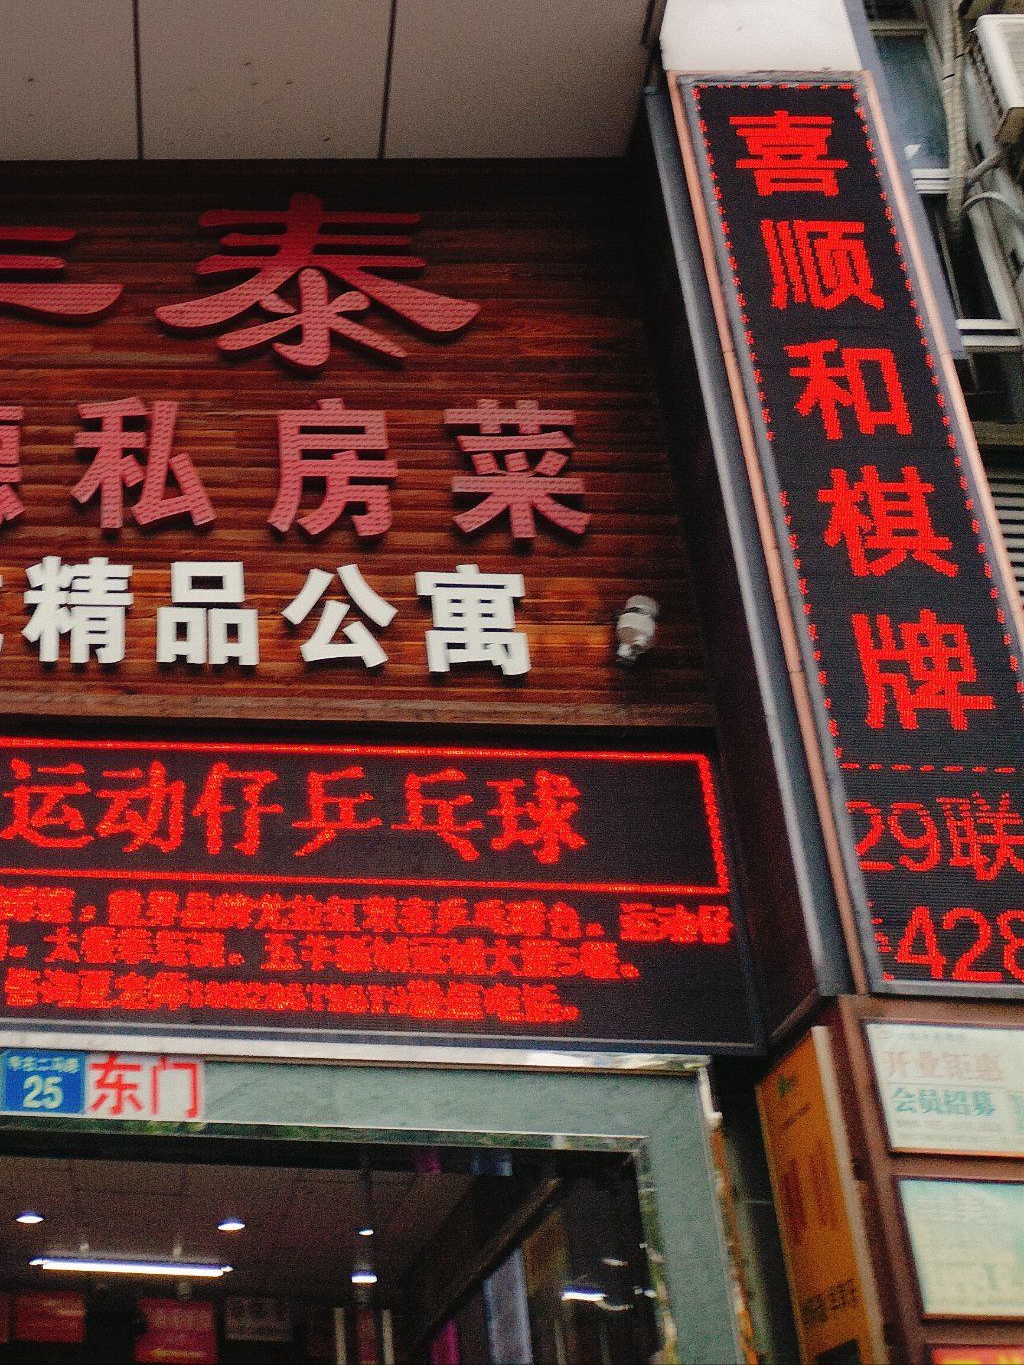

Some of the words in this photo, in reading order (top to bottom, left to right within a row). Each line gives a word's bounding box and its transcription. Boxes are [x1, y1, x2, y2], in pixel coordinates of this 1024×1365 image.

[730, 110, 995, 731] 喜顺和棋牌
[23, 1075, 64, 1109] 25
[89, 1054, 198, 1117] 东门
